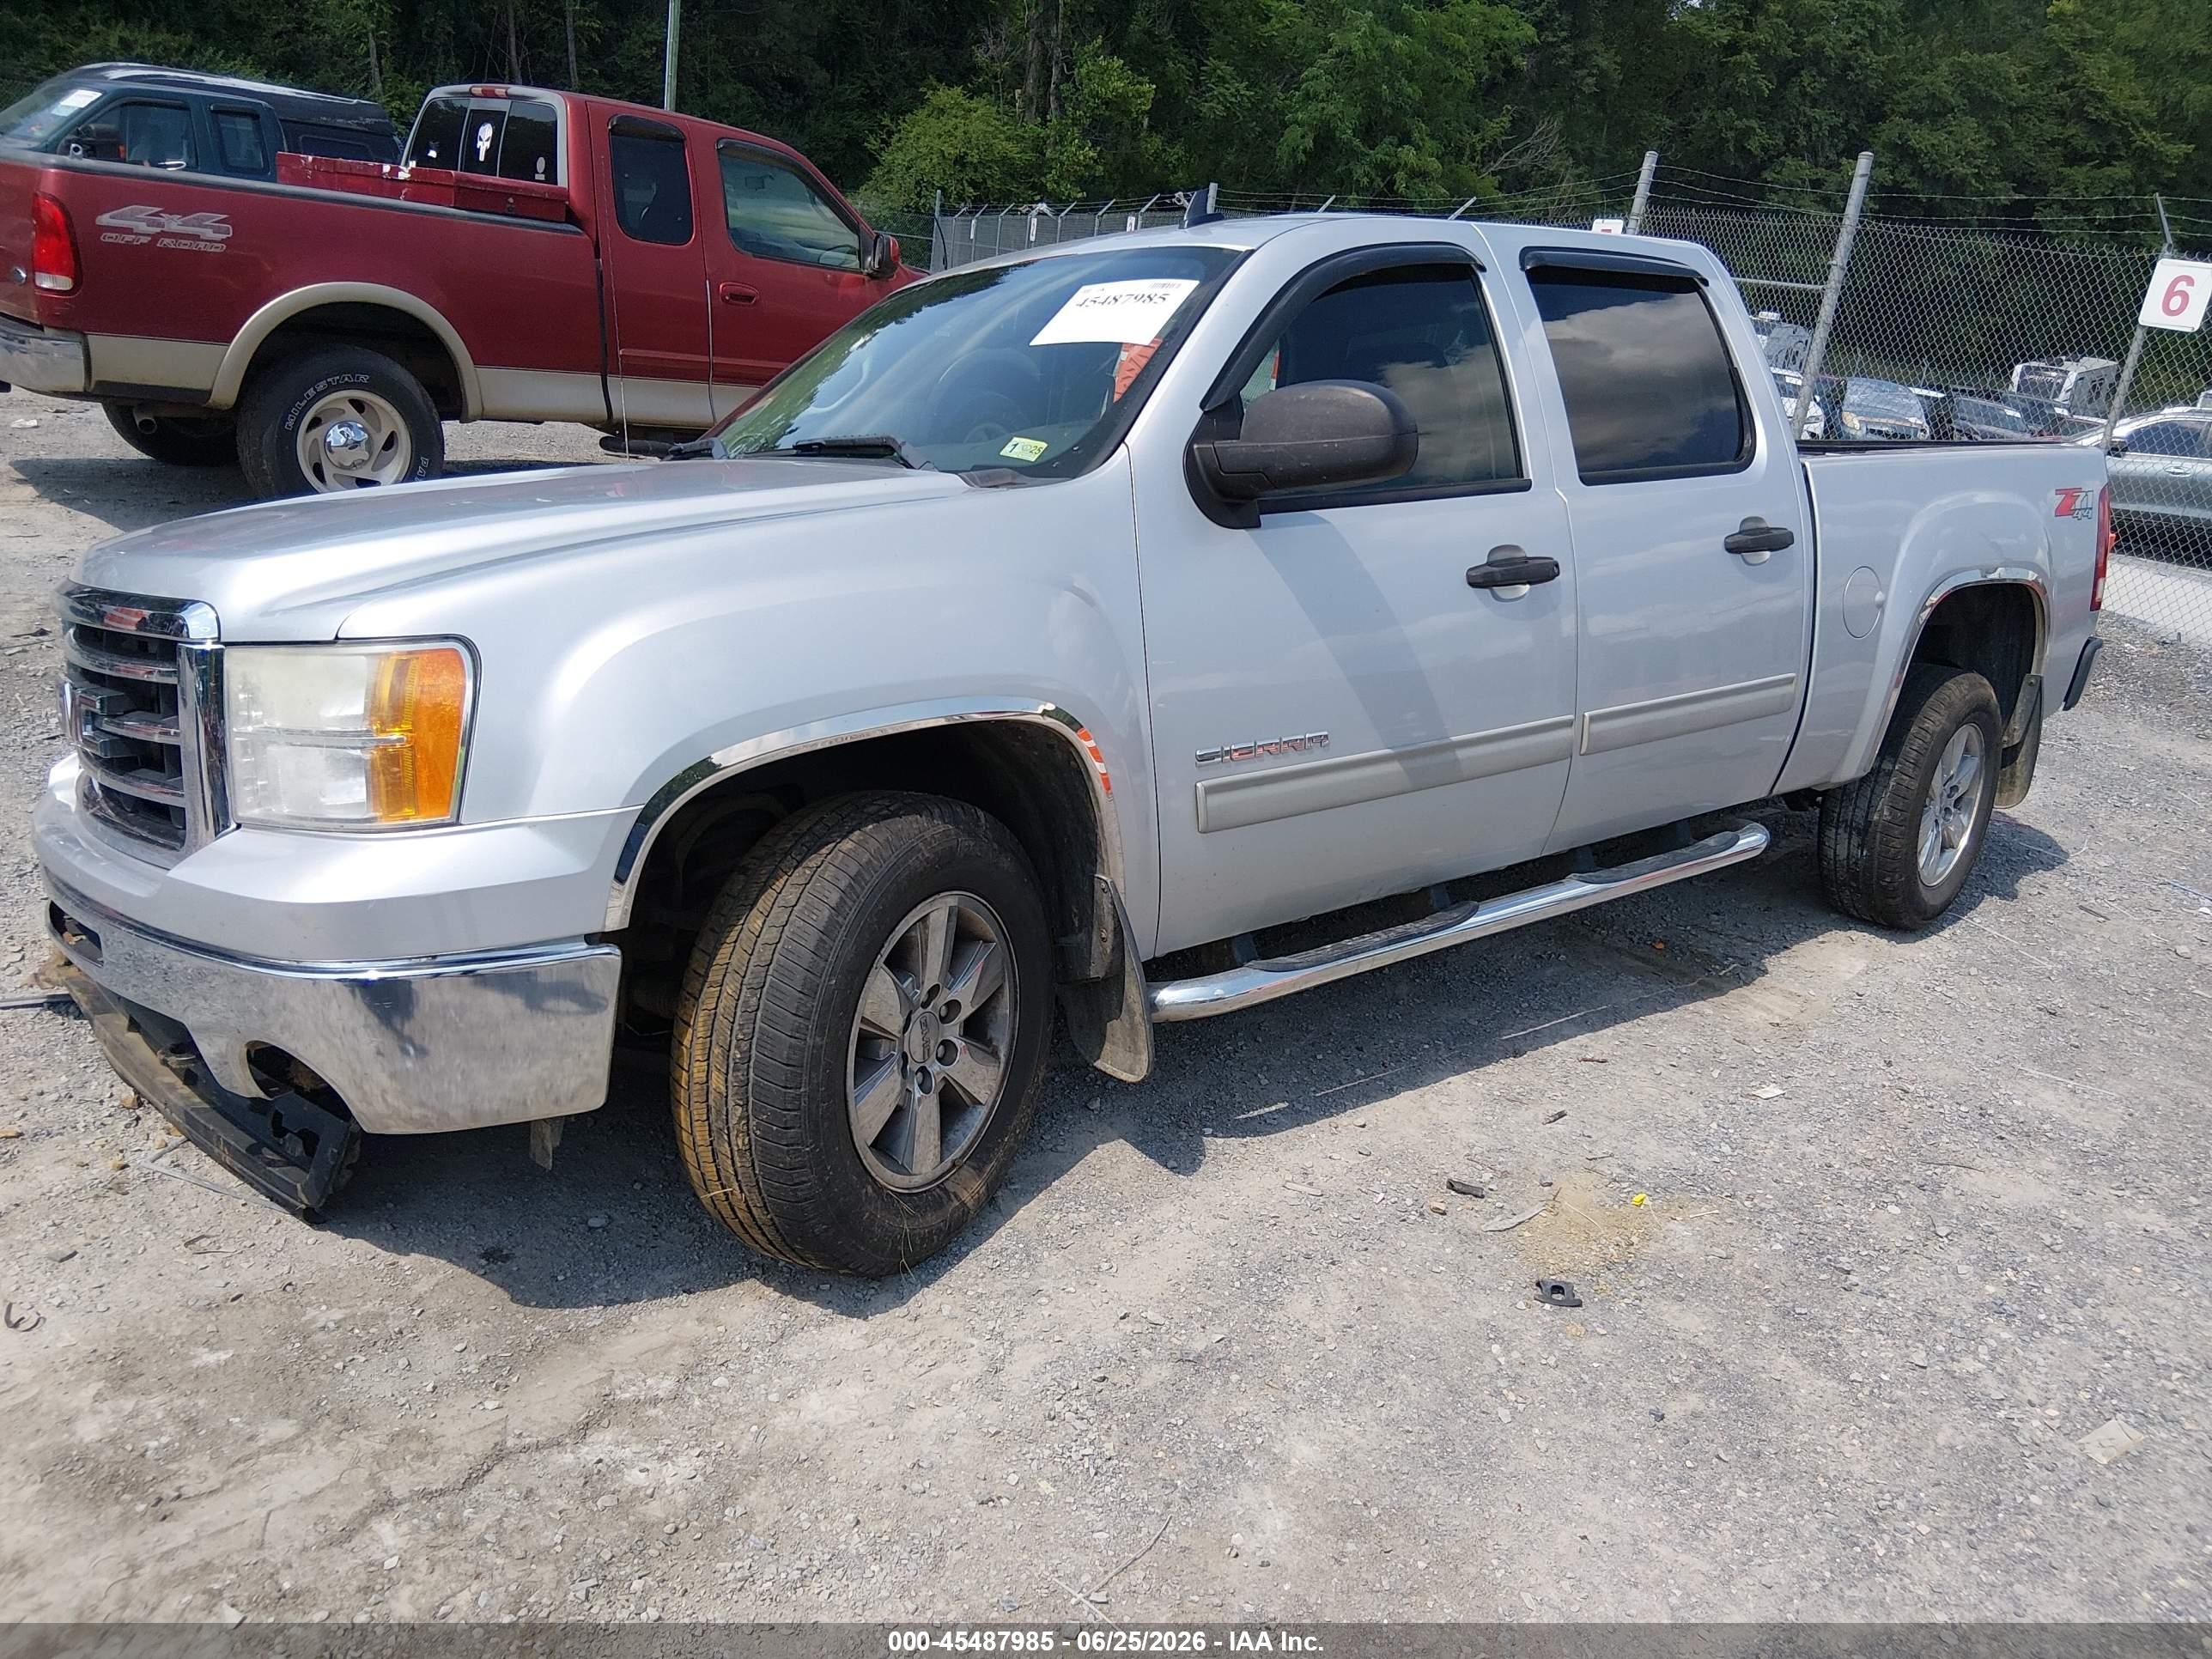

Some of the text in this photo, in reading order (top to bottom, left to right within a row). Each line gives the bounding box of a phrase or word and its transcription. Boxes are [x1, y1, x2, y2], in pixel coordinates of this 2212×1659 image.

[95, 204, 234, 241] 4x4
[100, 233, 227, 252] OFF ROAD
[1075, 293, 1170, 307] 45487985
[2161, 274, 2195, 317] 6
[284, 374, 370, 431] MILESTAR
[1030, 445, 1043, 455] 25
[2054, 487, 2094, 518] Z71
[1194, 731, 1329, 763] SIERRA
